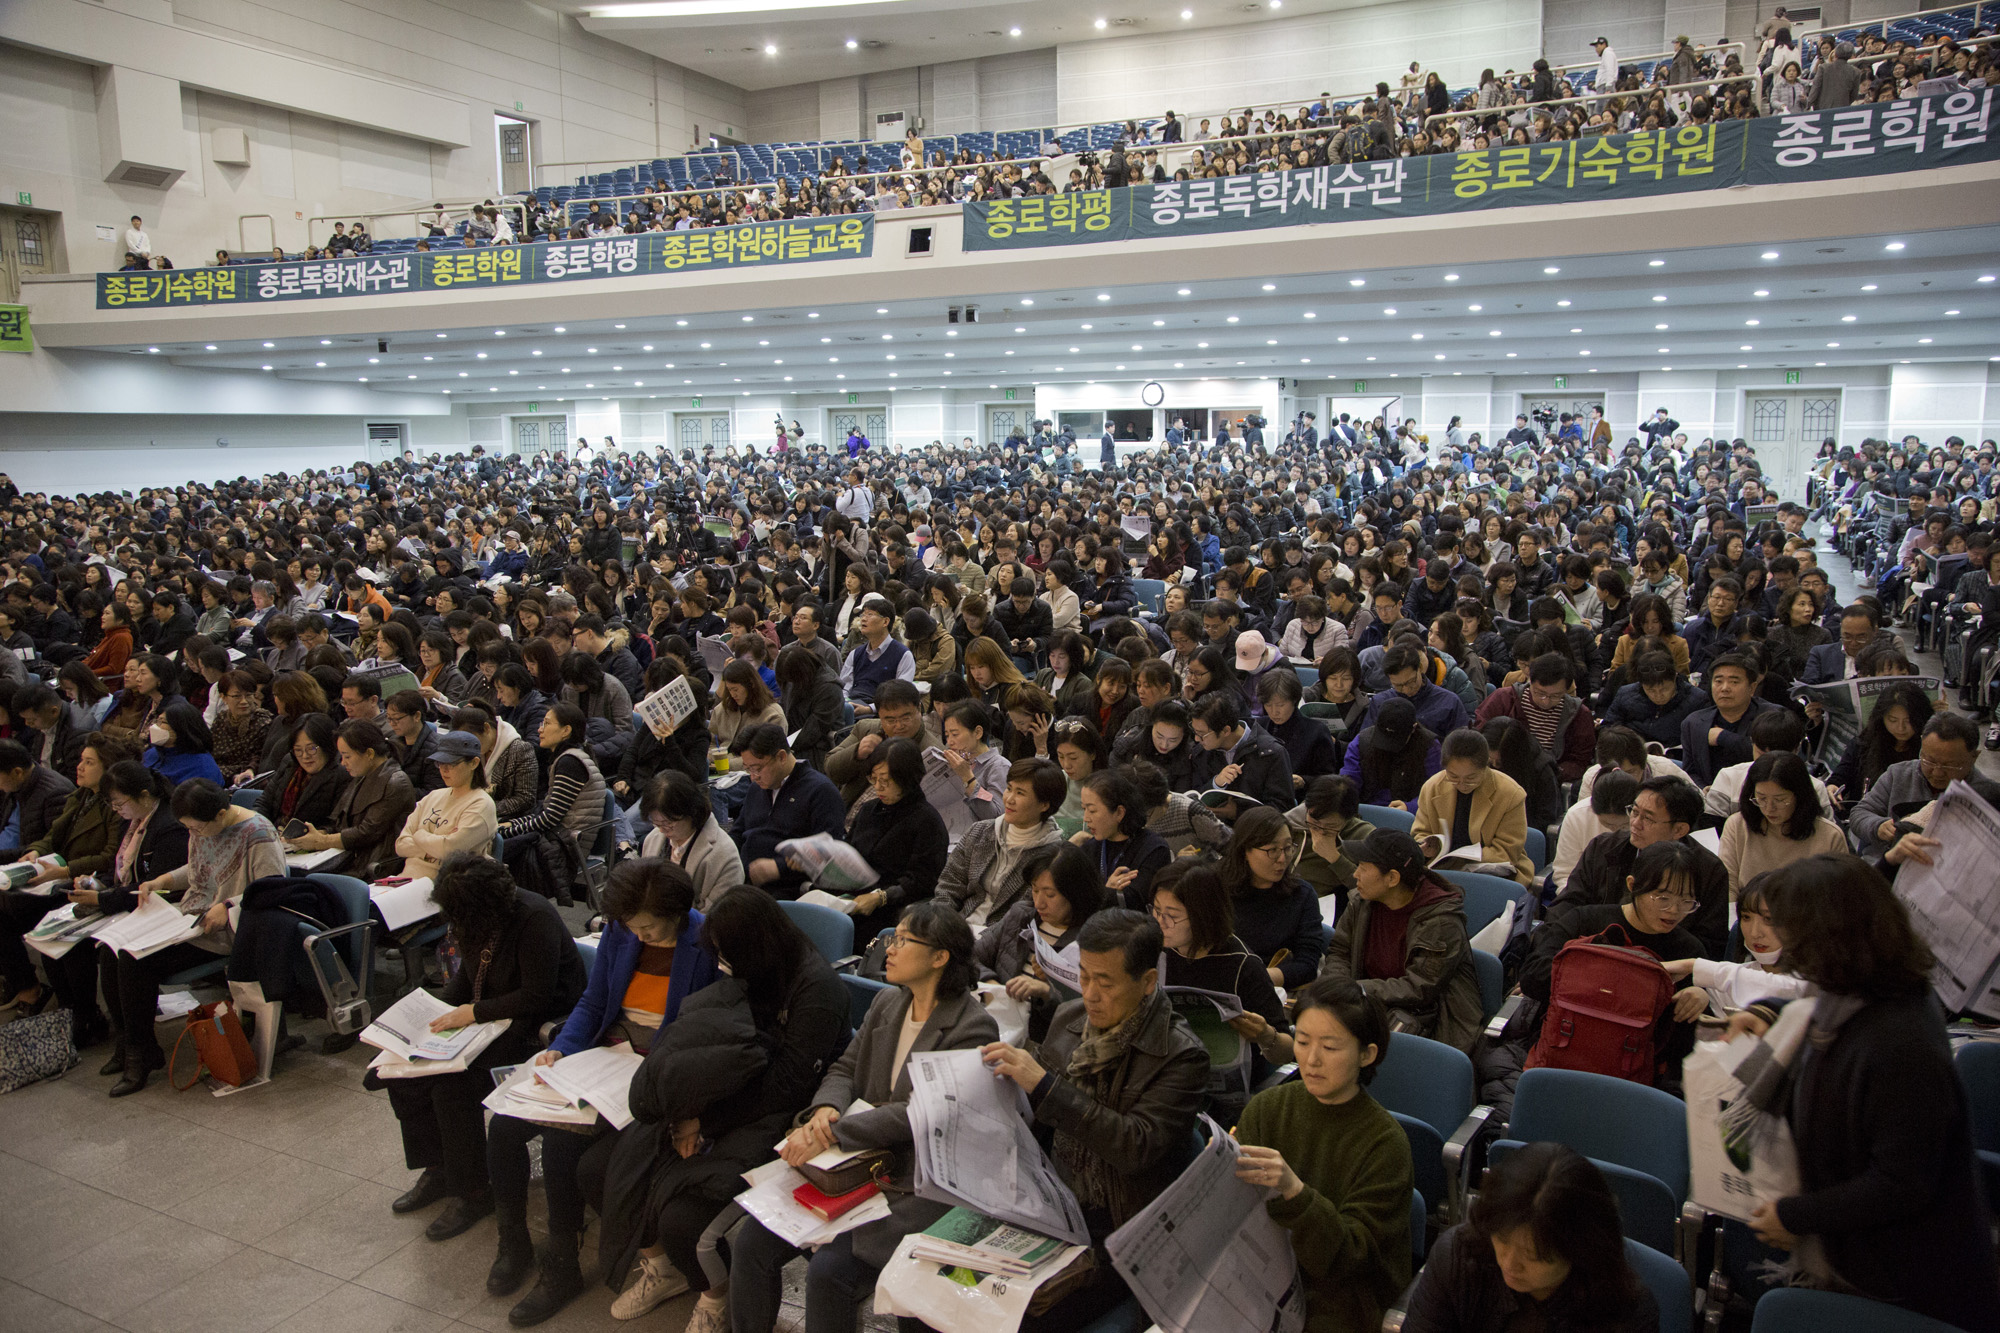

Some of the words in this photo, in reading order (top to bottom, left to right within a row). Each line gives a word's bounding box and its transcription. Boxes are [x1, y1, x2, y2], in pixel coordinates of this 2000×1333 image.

[986, 192, 1112, 239] 종로학평
[1150, 160, 1408, 226] 종로독학재수관
[1451, 124, 1717, 199] 종로기숙학원
[1774, 90, 1991, 167] 종로학원
[105, 269, 236, 306] 종로기숙학원
[256, 257, 411, 299] 종로독학재수관
[432, 249, 522, 287] 종로학원
[544, 238, 639, 279] 종로학평
[662, 218, 866, 269] 종로학원하늘교육
